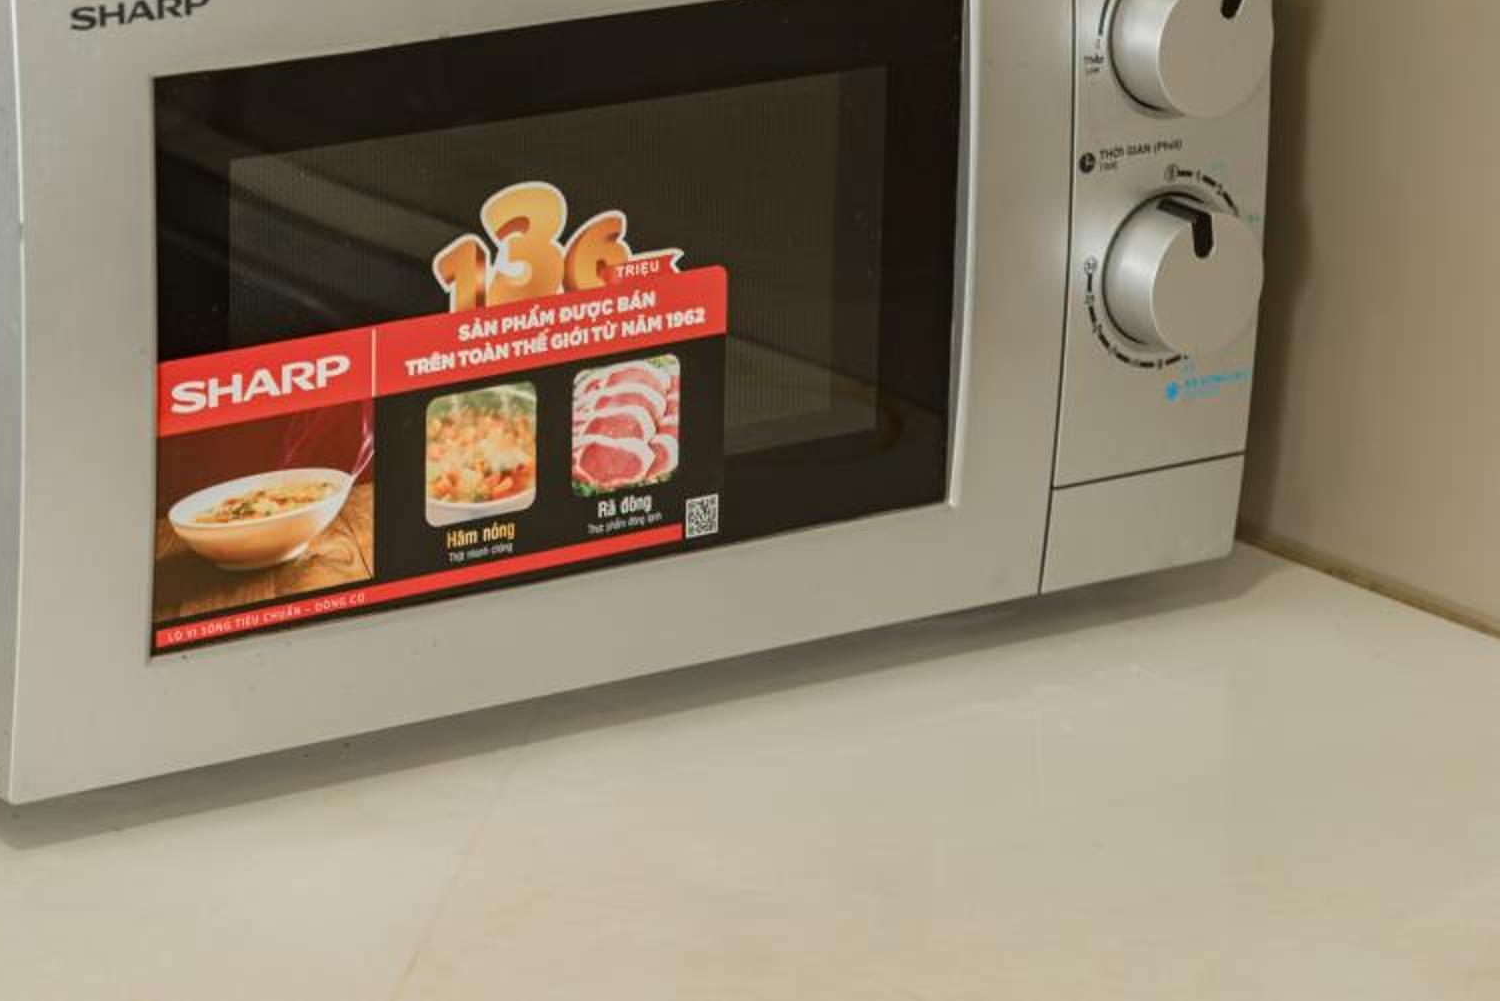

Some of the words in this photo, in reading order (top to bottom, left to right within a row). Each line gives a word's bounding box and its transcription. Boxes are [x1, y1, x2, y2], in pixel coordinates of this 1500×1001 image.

[404, 347, 456, 376] TRÊN
[458, 340, 510, 368] TOÀN
[511, 328, 550, 356] THẾ
[551, 324, 589, 349] GIỚI
[591, 321, 619, 342] TỪ
[621, 314, 662, 337] NĂM
[665, 307, 706, 330] 1962
[458, 316, 498, 342] SẢN
[501, 303, 555, 335] PHẨM
[558, 297, 614, 325] ĐƯỢC
[617, 290, 656, 312] BÁN
[171, 355, 350, 414] SHARP
[483, 521, 515, 542] nóng
